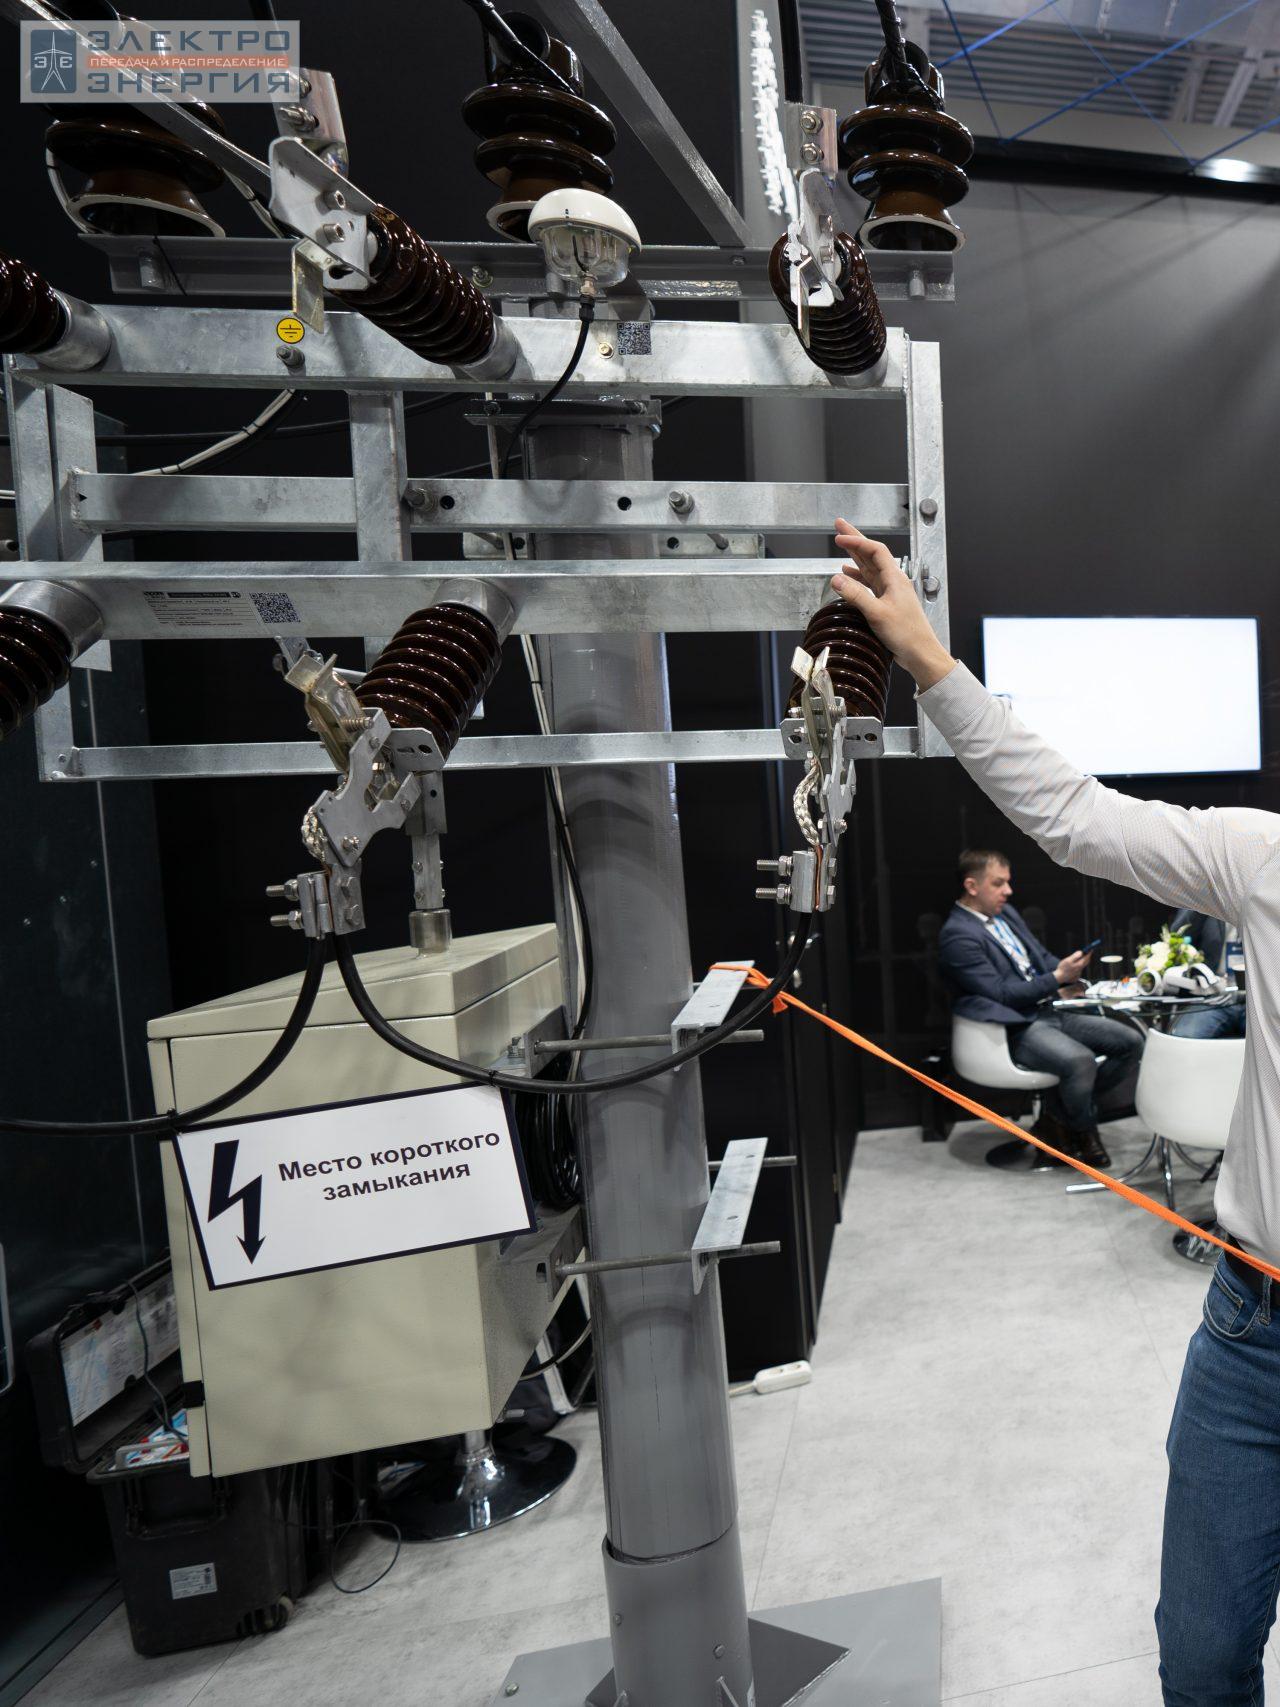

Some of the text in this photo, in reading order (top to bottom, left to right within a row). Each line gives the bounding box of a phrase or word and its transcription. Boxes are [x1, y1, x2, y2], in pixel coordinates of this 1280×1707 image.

[278, 1132, 500, 1181] Место короткого
[323, 1163, 471, 1201] замыкания
